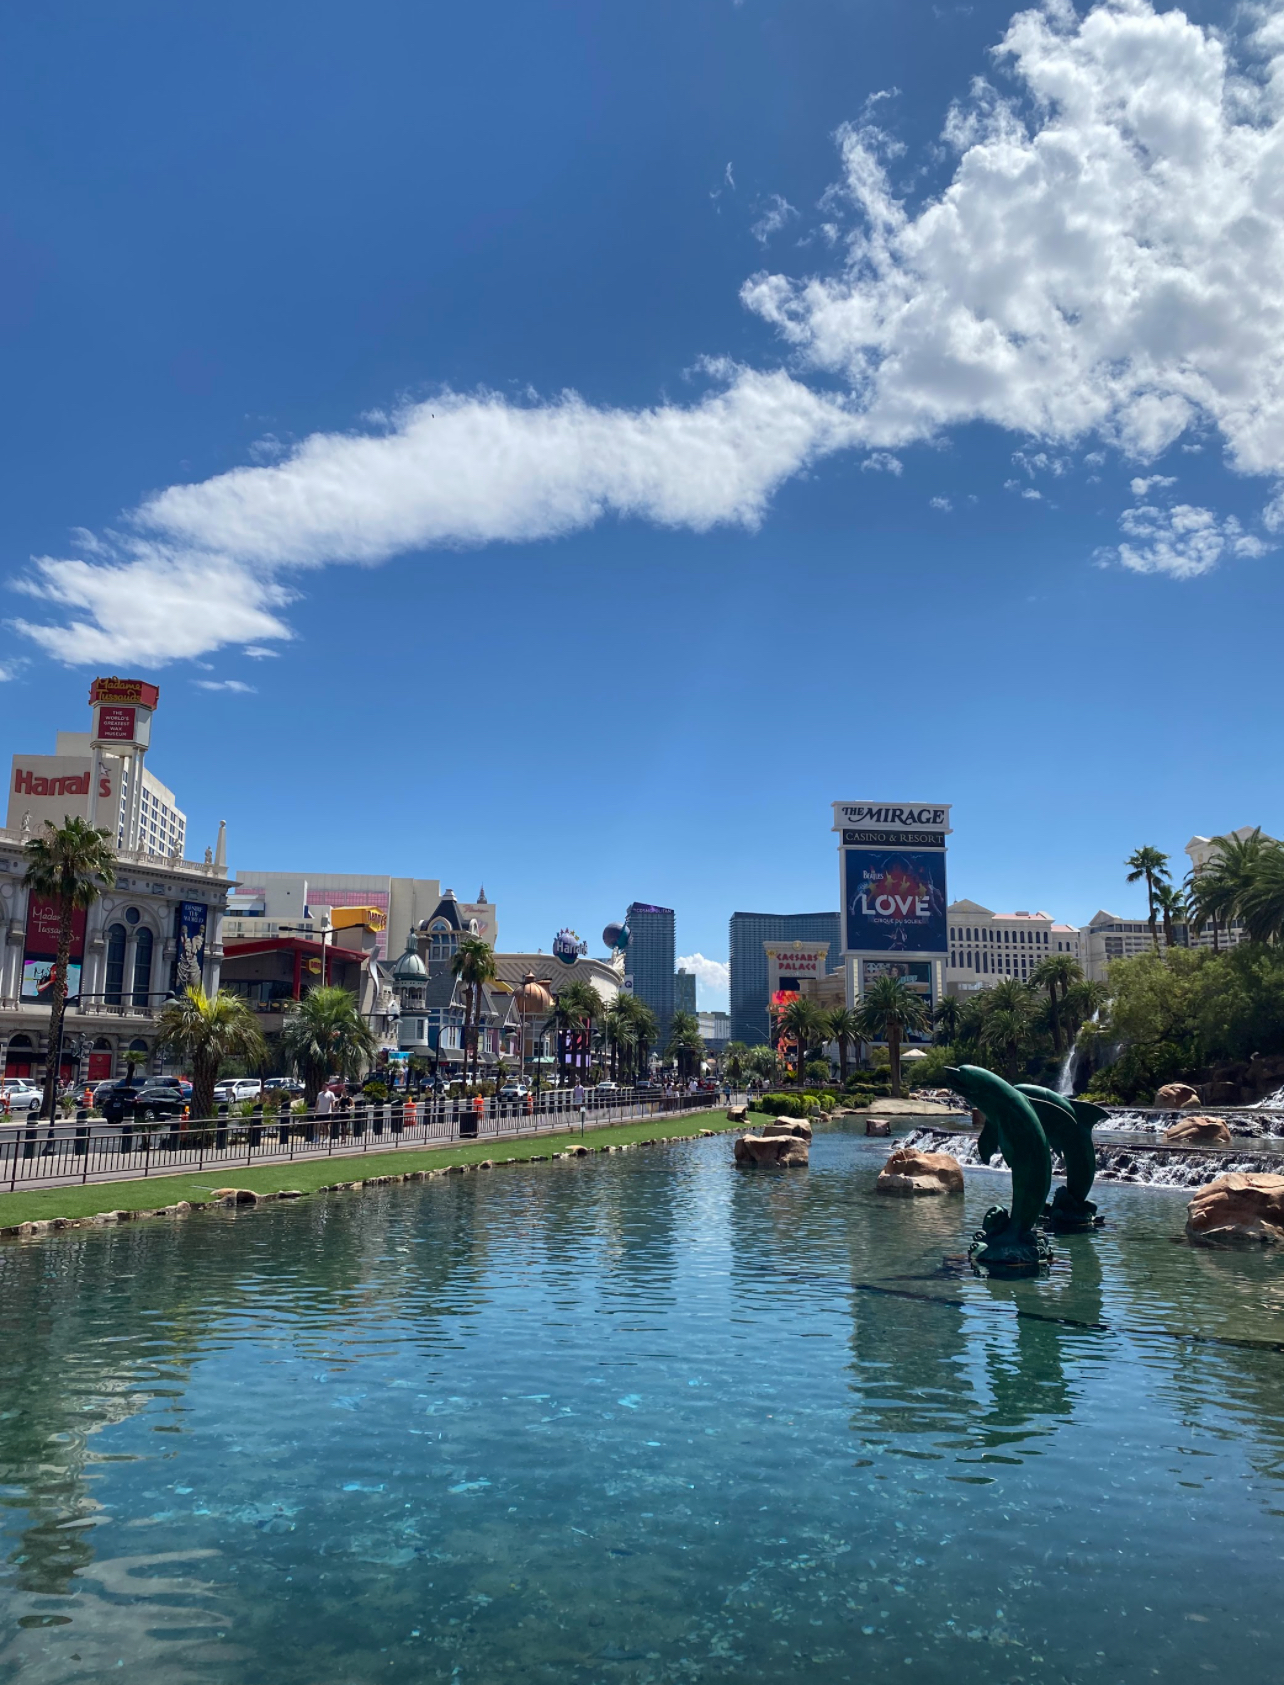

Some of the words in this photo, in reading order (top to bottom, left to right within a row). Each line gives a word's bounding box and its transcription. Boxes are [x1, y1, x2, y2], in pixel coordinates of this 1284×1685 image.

[96, 676, 142, 690] Madame
[96, 689, 142, 702] Tussauds
[842, 806, 864, 816] THE
[848, 807, 945, 826] MIRAGE
[845, 832, 886, 842] CASINO
[889, 834, 897, 842] &
[900, 834, 943, 844] RESORT
[863, 870, 884, 880] BEATLES
[861, 894, 931, 916] LOVE
[776, 953, 818, 961] CAESARS
[779, 962, 816, 971] PALACE
